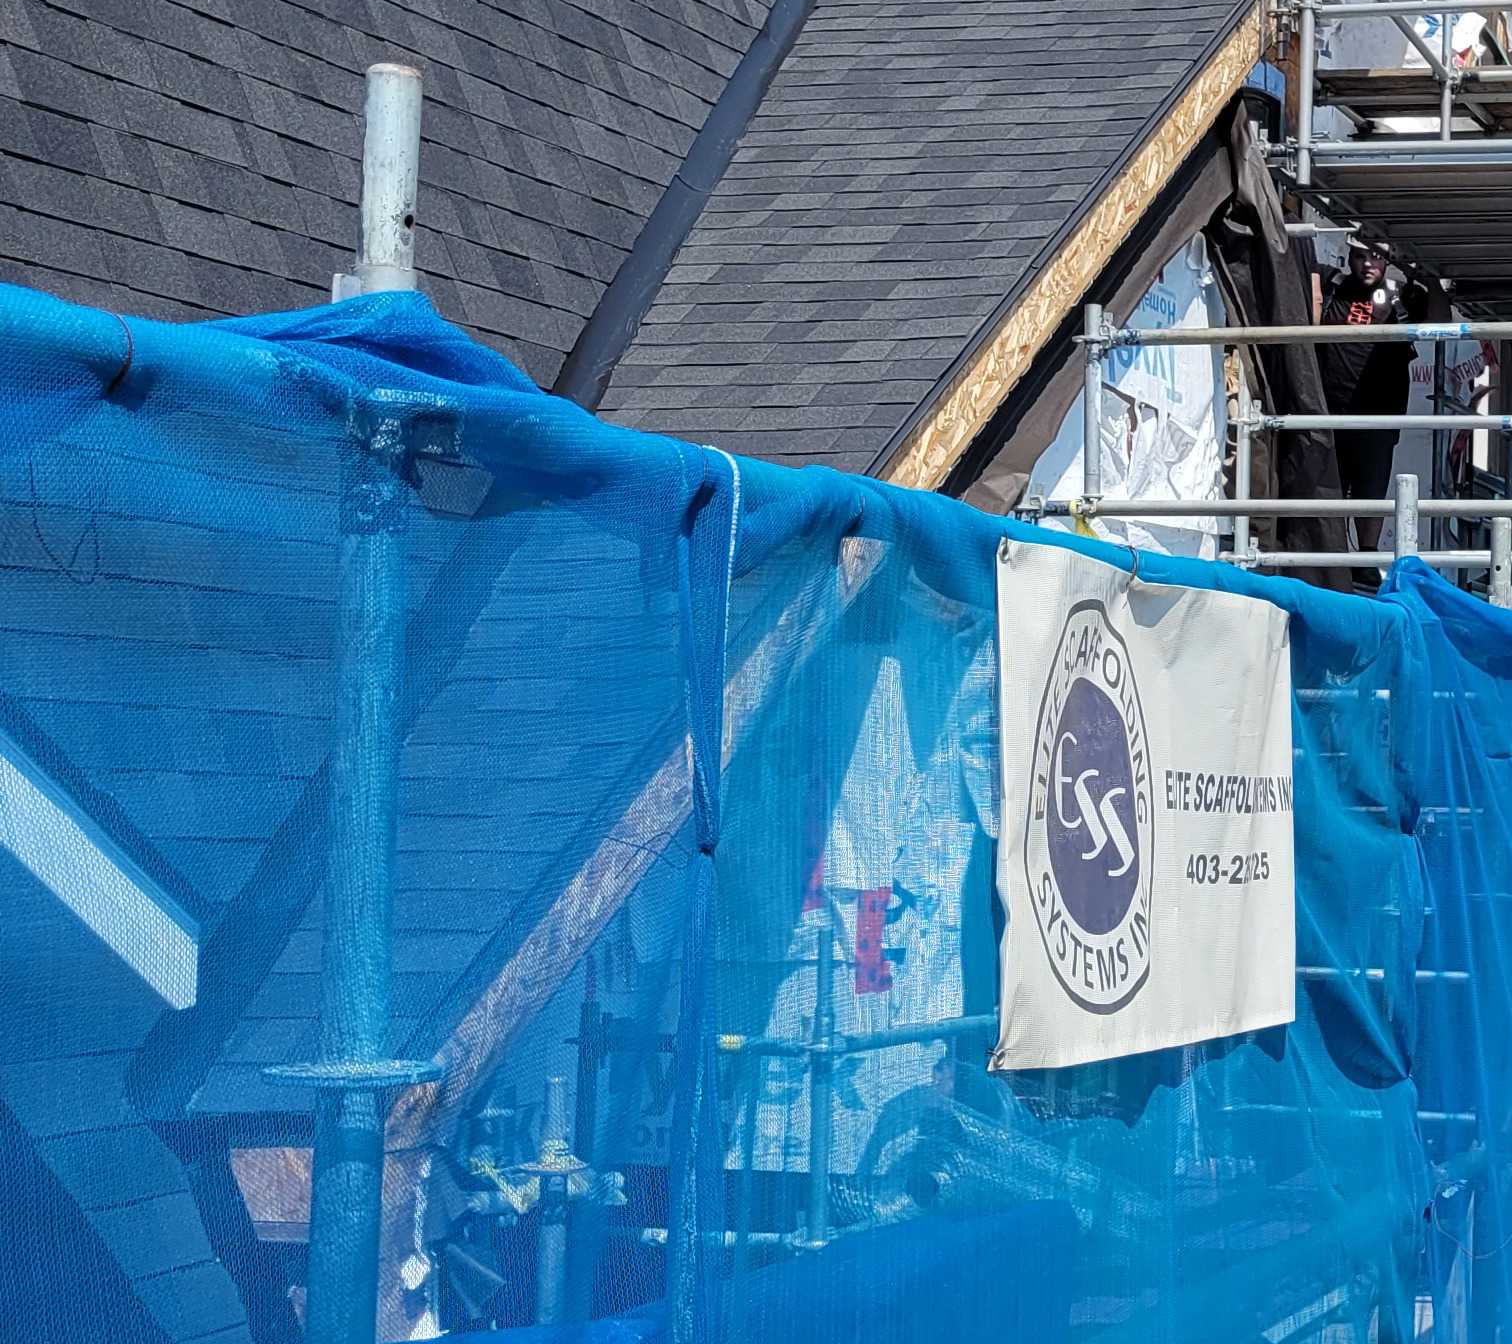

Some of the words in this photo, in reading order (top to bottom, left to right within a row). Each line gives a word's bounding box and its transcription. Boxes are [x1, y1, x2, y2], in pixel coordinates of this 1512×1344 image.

[1035, 685, 1062, 821] ELITE
[1064, 624, 1148, 825] SCAFFOLDING
[1038, 871, 1129, 992] SYSTEMS
